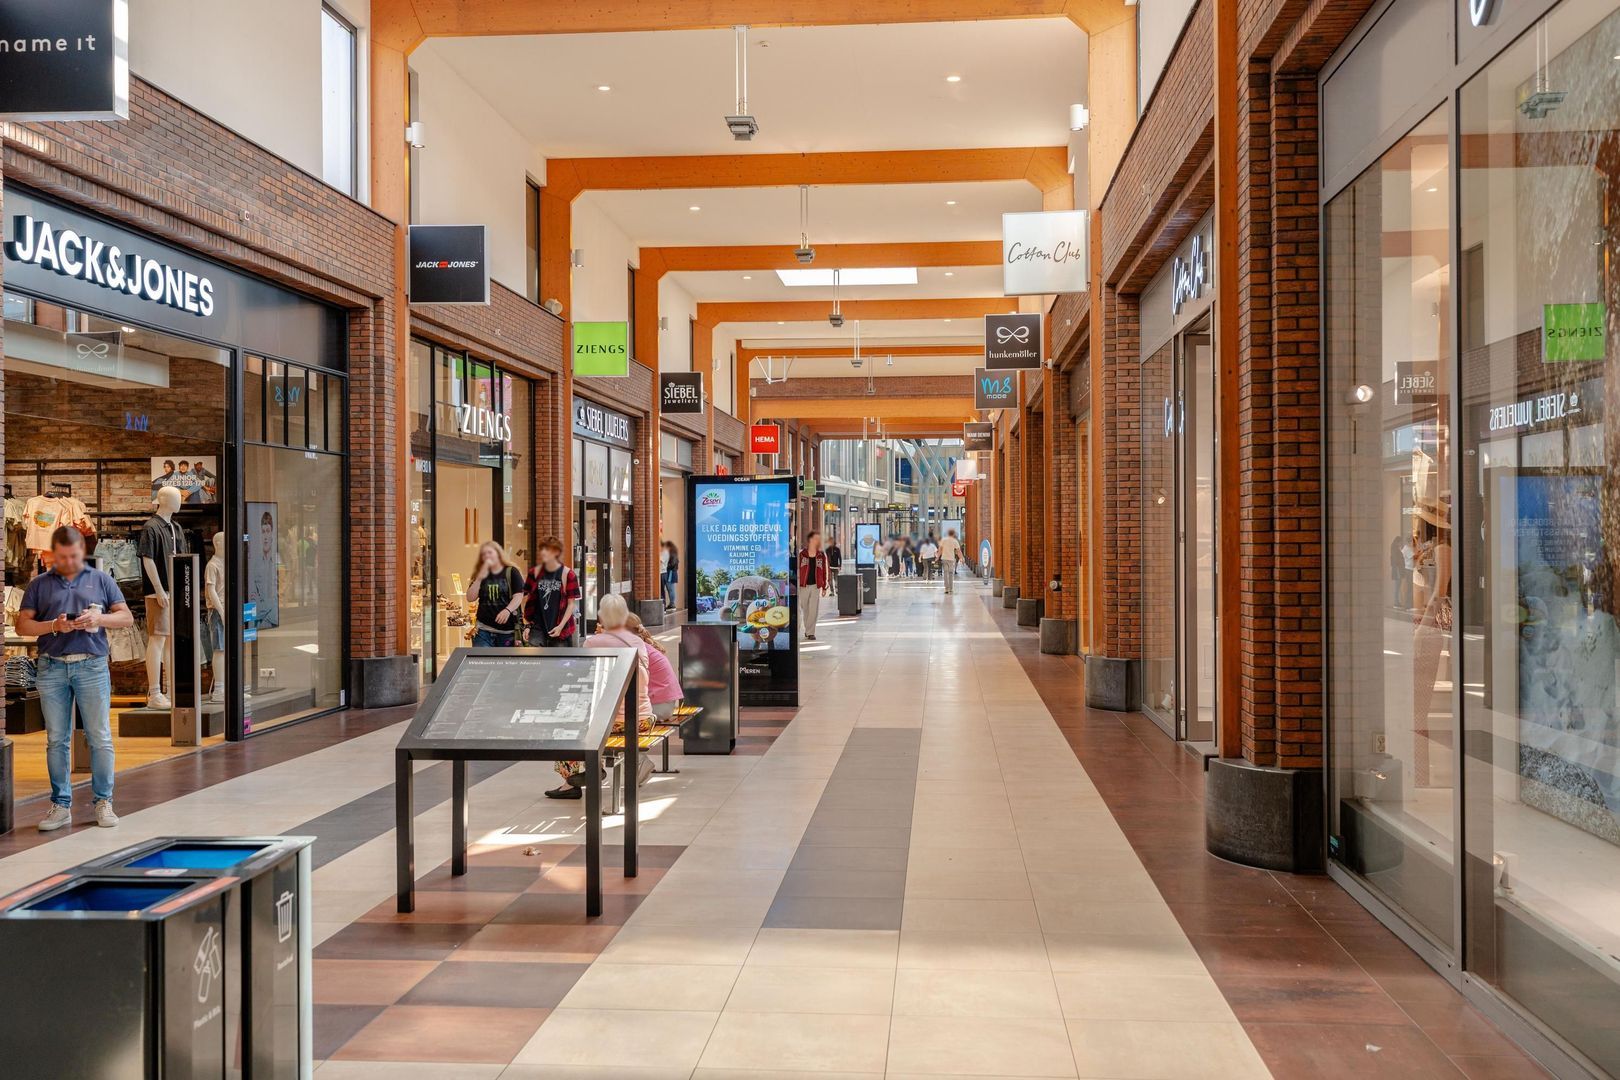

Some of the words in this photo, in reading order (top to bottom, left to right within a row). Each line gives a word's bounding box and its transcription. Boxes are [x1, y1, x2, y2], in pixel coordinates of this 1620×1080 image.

[0, 38, 68, 52] name
[1007, 242, 1051, 264] Cotton
[1053, 241, 1081, 264] Club
[11, 214, 215, 317] JACK&JONES
[576, 344, 625, 354] ZIENGS
[988, 350, 1038, 359] hunkemöller
[664, 387, 699, 399] SIEBEL
[462, 404, 512, 441] ZIENGS
[586, 406, 604, 434] SIEBEL
[702, 524, 720, 532] ELKE
[722, 524, 737, 532] DAG
[739, 524, 782, 532] BOORDEVOL
